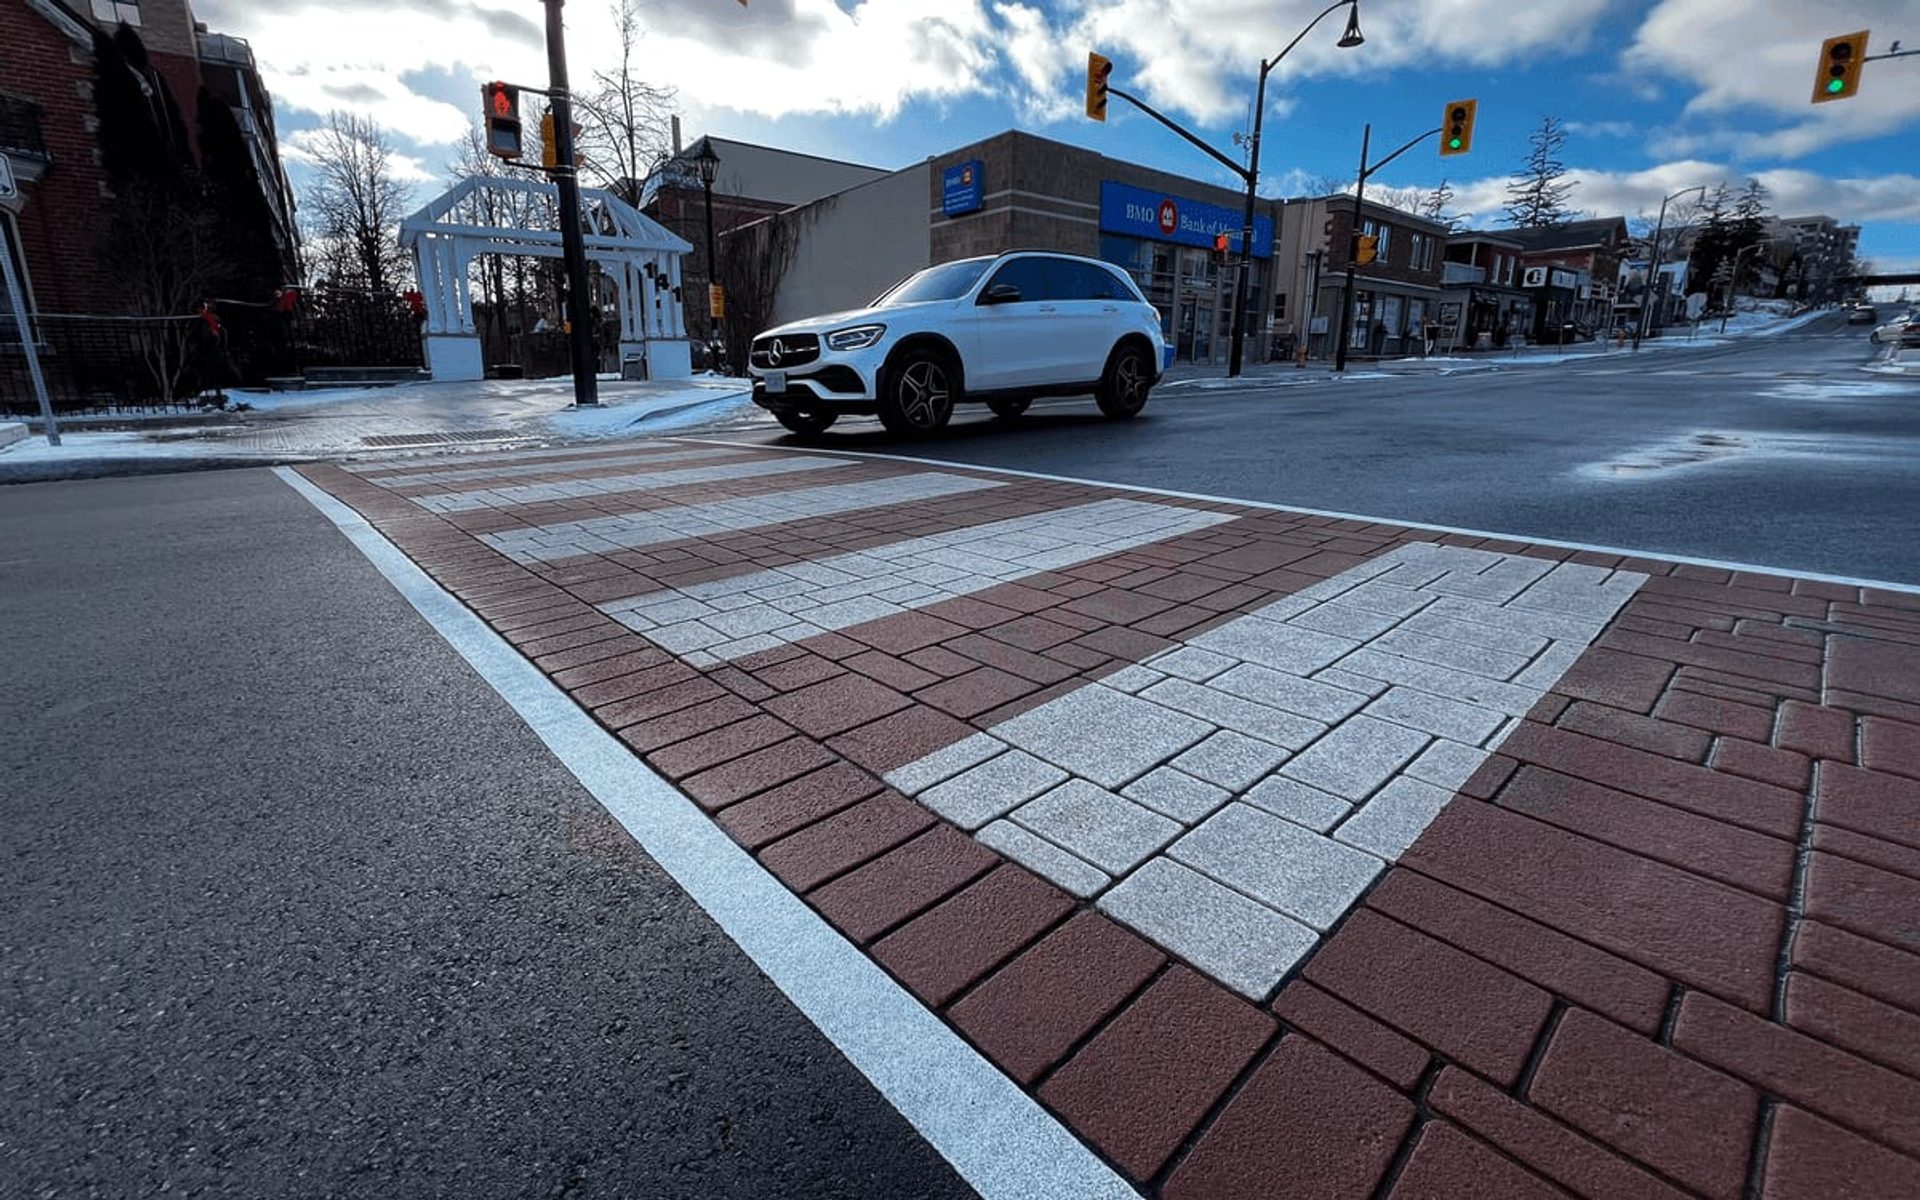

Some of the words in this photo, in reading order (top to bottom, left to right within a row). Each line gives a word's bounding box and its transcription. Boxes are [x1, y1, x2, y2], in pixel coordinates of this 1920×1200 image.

[1126, 203, 1154, 223] BMO
[1180, 214, 1206, 233] Bank
[1206, 220, 1218, 235] of
